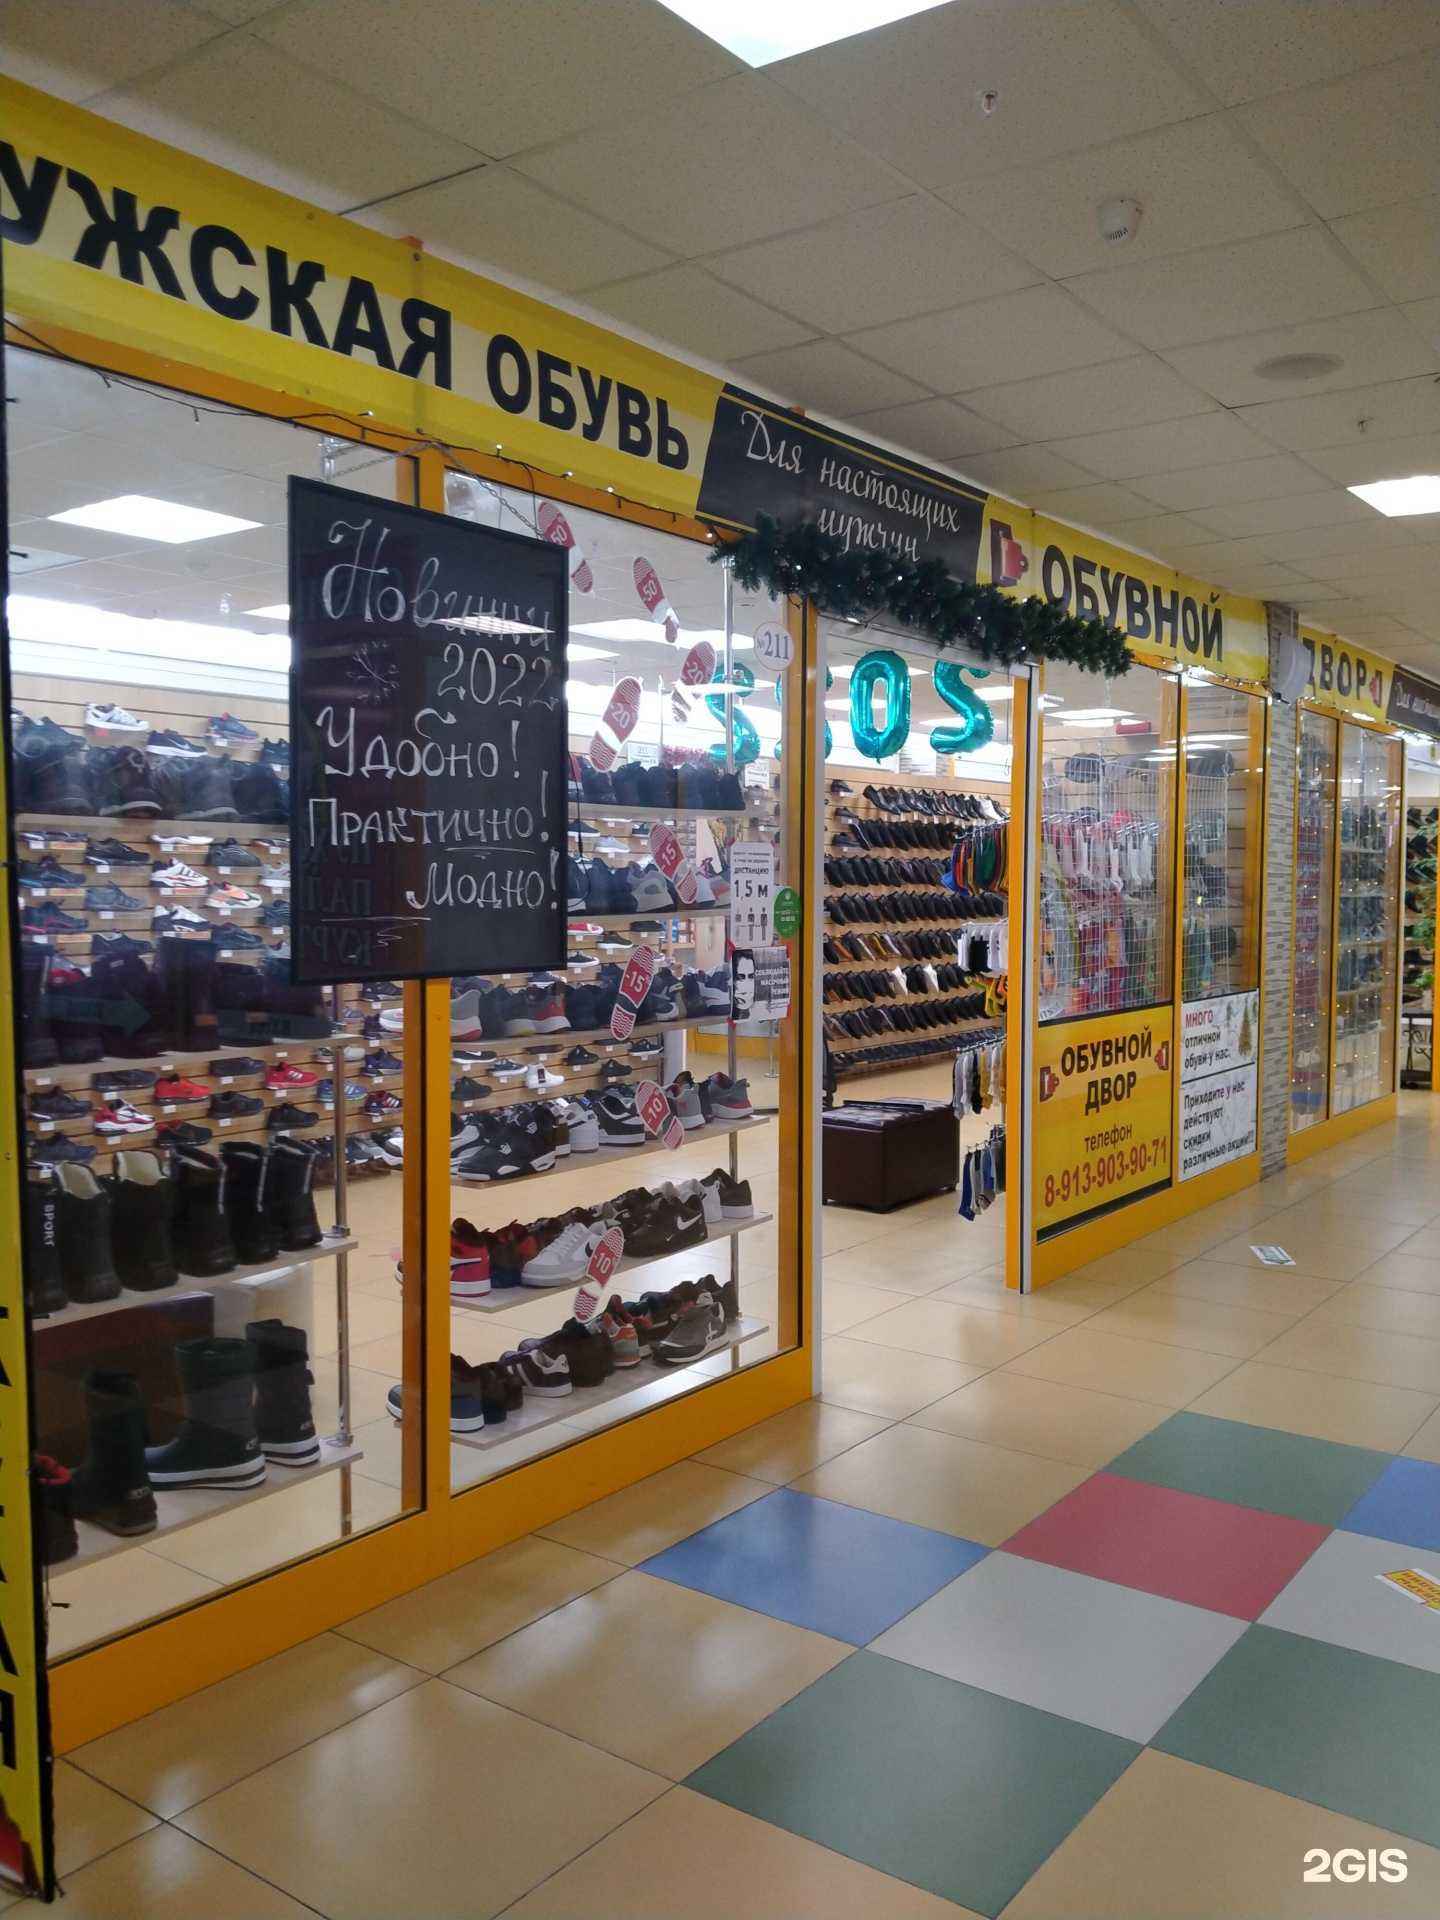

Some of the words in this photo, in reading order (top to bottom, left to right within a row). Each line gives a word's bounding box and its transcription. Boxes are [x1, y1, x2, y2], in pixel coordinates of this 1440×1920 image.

[0, 140, 452, 390] УЖСКАЯ
[487, 334, 689, 470] ОБУВЬ
[742, 411, 804, 474] Для
[820, 457, 960, 542] настоящих
[817, 508, 920, 562] мужчин
[322, 518, 550, 652] Новинки
[1042, 544, 1222, 663] ОБУВНОЙ
[437, 642, 560, 711] 2022
[316, 706, 521, 779] Удобно!
[406, 848, 560, 910] Модно!
[1061, 1025, 1152, 1077] ОБУВНОЙ
[1084, 1071, 1137, 1116] ДВОР
[1184, 1087, 1225, 1110] Приходите
[1184, 1107, 1223, 1131] действуют
[1084, 1122, 1133, 1153] телефон
[1044, 1136, 1168, 1207] 8-913-903-90-71
[43, 1204, 55, 1248] SPORT
